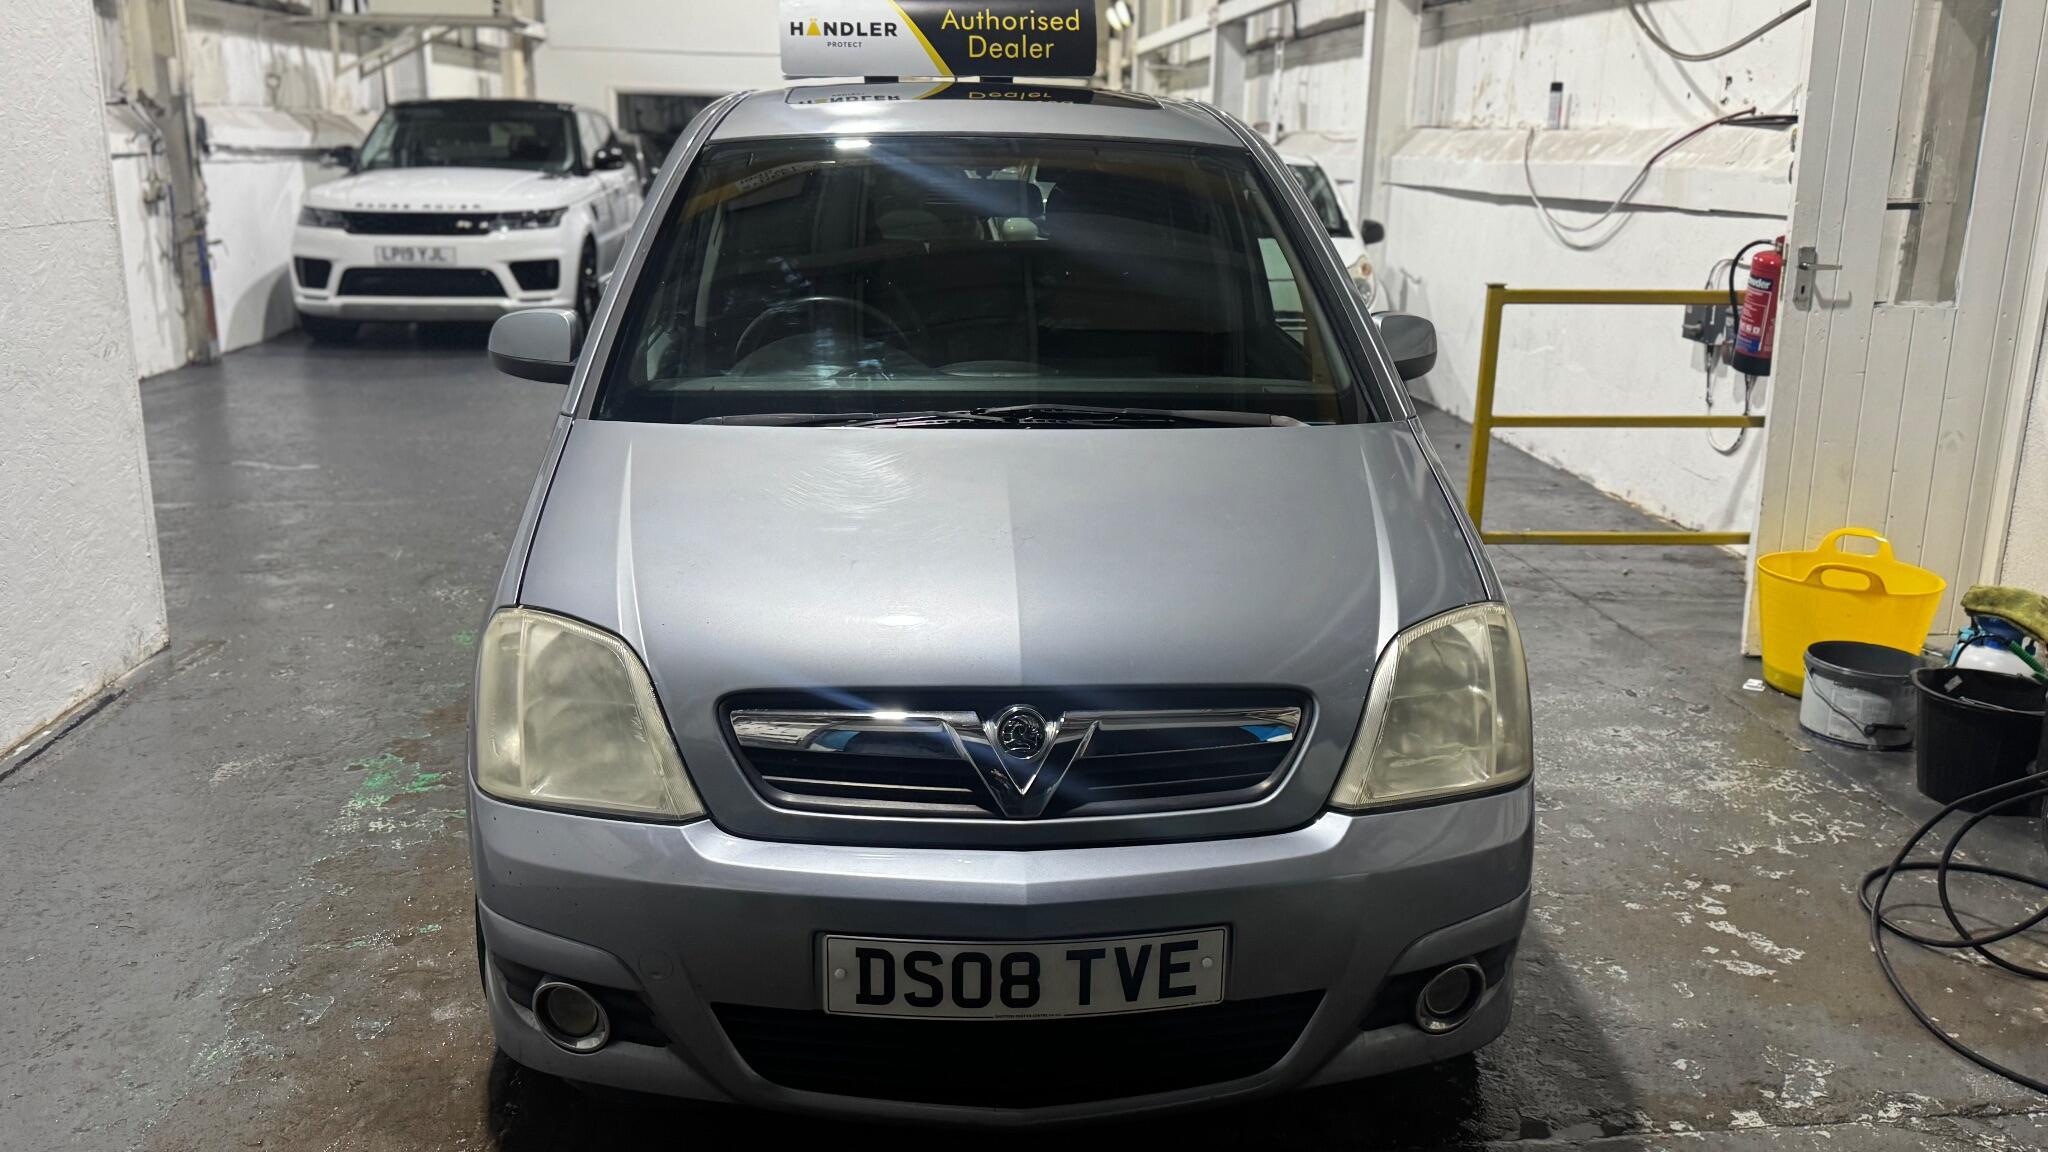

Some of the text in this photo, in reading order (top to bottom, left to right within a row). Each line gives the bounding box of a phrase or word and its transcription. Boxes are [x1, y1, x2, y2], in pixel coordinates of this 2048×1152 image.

[941, 9, 1080, 31] Authorised
[968, 35, 1055, 58] Dealer
[417, 247, 447, 261] YJL
[855, 939, 1199, 1008] DS08 TVE
